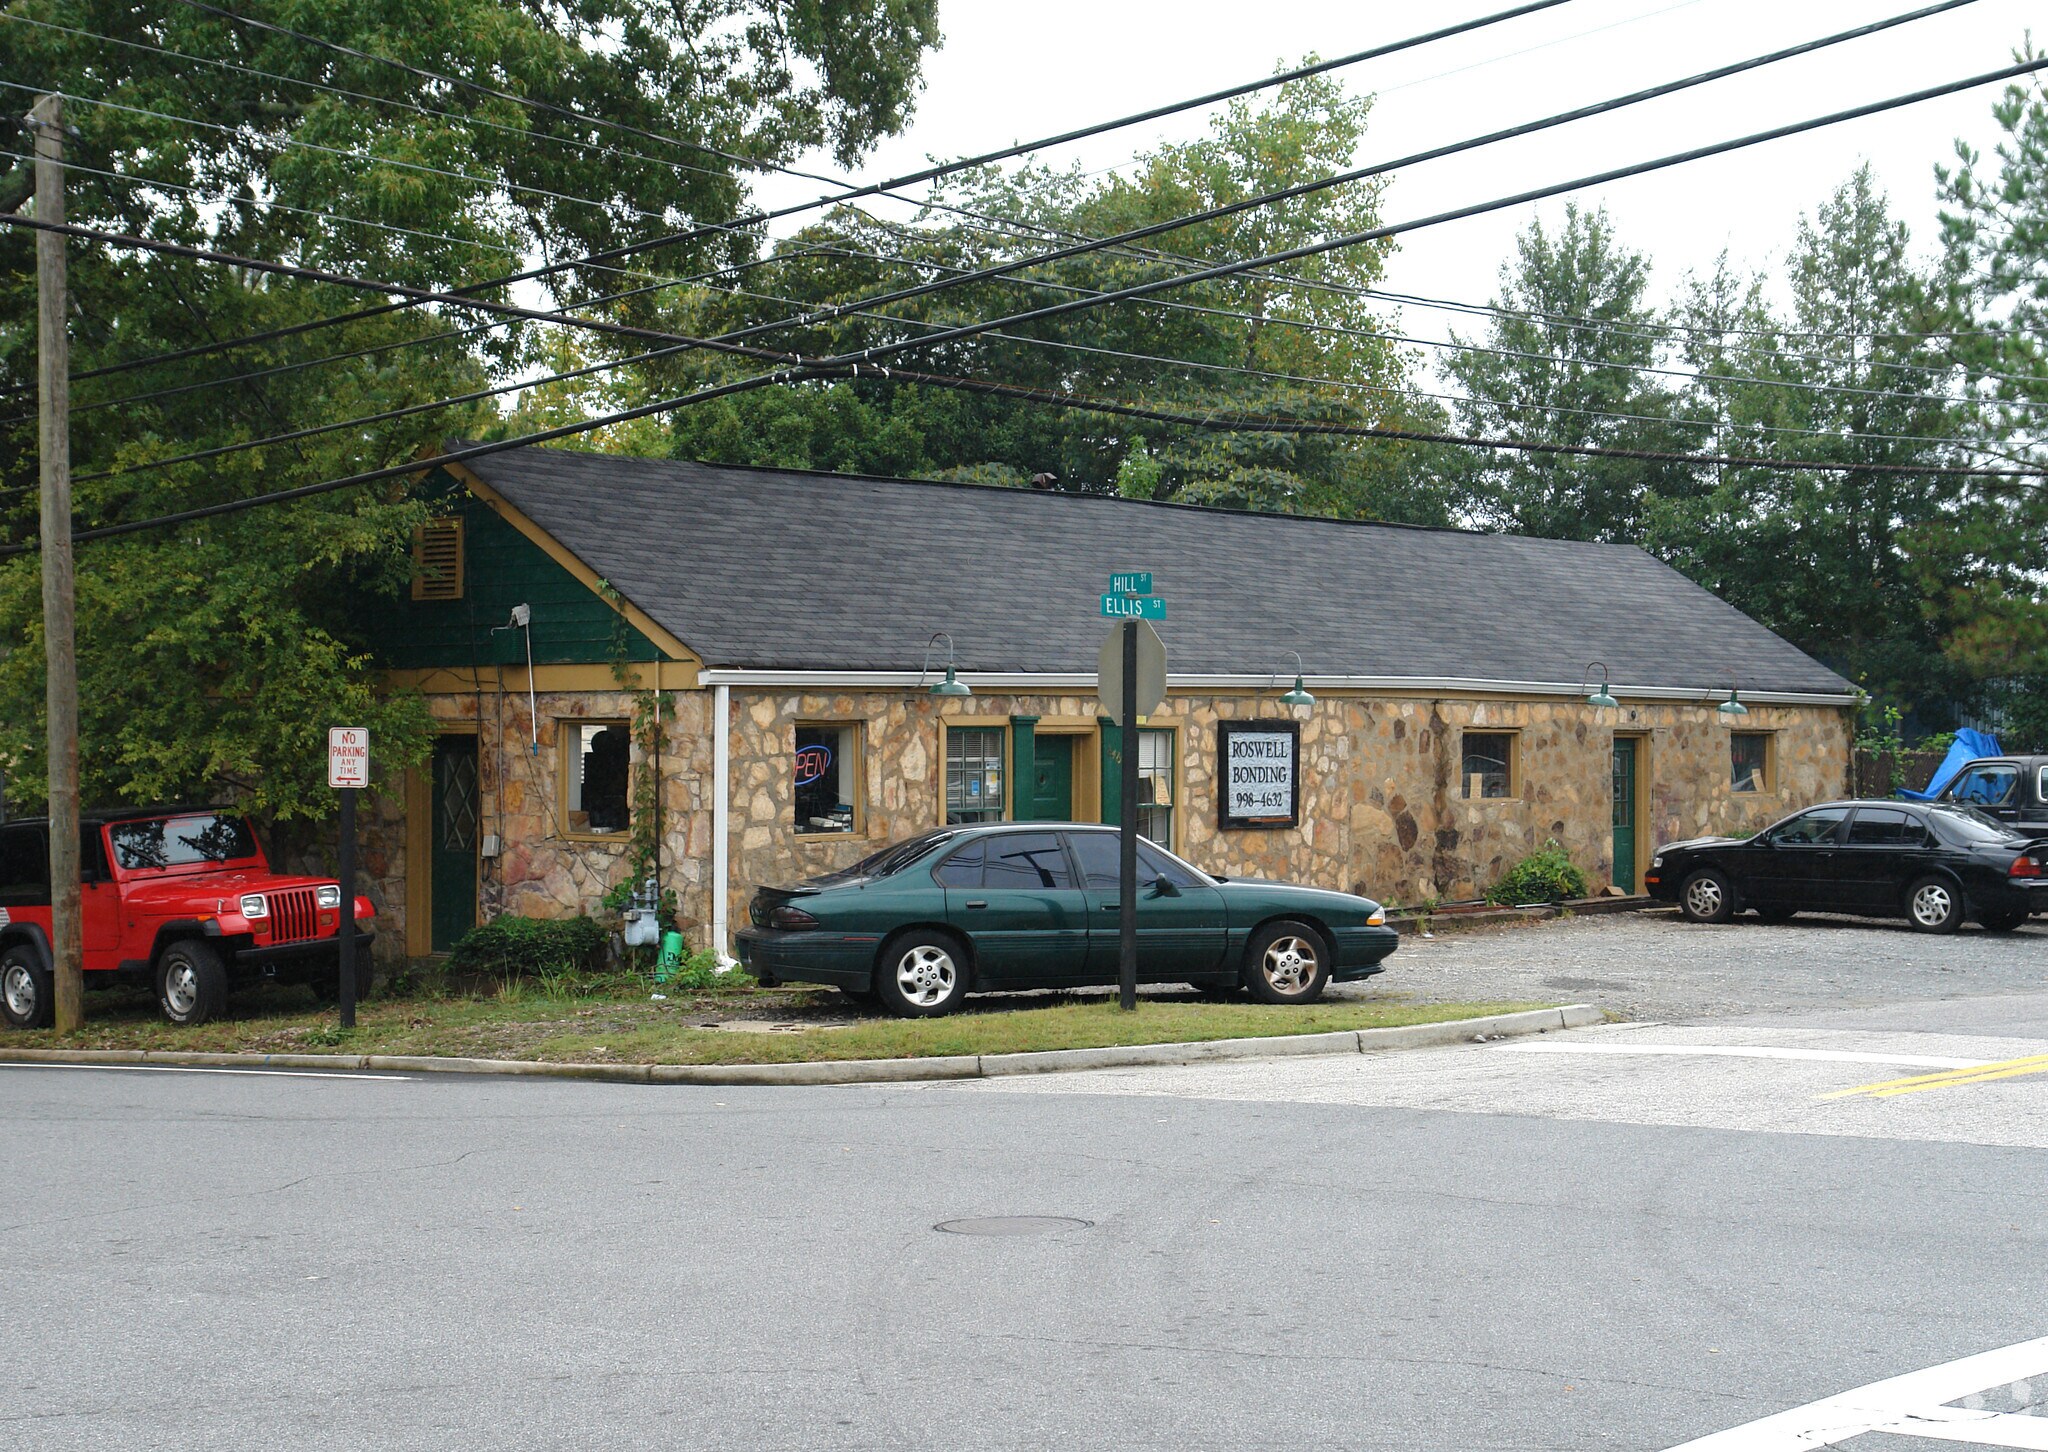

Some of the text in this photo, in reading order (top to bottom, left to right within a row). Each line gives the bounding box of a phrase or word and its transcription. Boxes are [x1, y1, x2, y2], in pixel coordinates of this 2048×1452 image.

[1113, 574, 1147, 592] HILL ST
[1106, 597, 1161, 615] ELLIS ST
[341, 733, 357, 745] NO
[332, 745, 365, 758] PARKING
[1231, 741, 1289, 758] ROSWELL
[339, 766, 358, 775] TIME
[340, 758, 357, 766] ANY
[794, 752, 828, 778] PEN
[1232, 766, 1288, 784] BONDING
[1235, 791, 1284, 809] 998-4632
